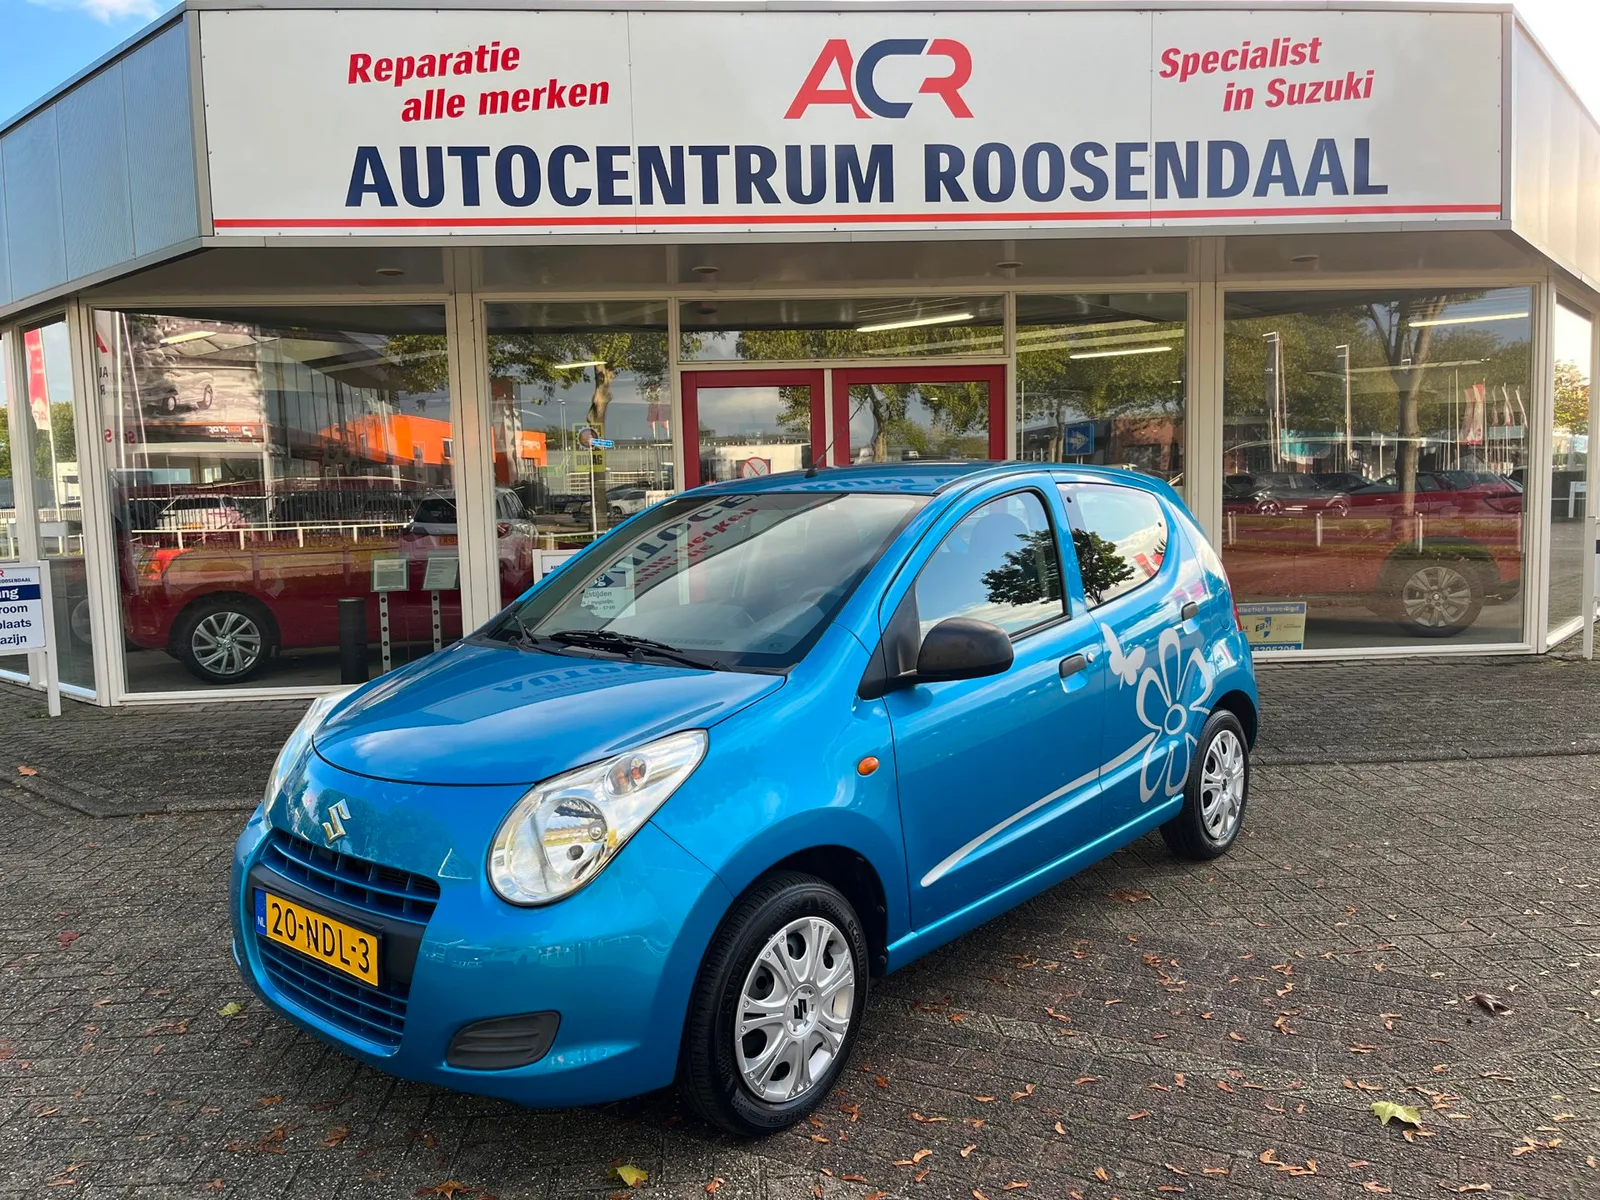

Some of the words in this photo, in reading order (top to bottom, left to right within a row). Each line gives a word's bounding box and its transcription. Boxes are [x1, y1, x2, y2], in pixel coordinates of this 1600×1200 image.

[348, 41, 520, 87] Reparatie
[784, 38, 974, 119] ACR
[1159, 37, 1322, 82] Specialist
[402, 87, 466, 122] alle
[479, 79, 610, 117] merken
[1223, 82, 1253, 112] in
[1264, 70, 1375, 108] Suzuki
[345, 144, 895, 208] AUTOCENTRUM
[924, 138, 1388, 203] ROOSENDAAL
[0, 588, 19, 600] ng
[257, 915, 266, 928] NL
[271, 902, 370, 974] 20-NDL-3
